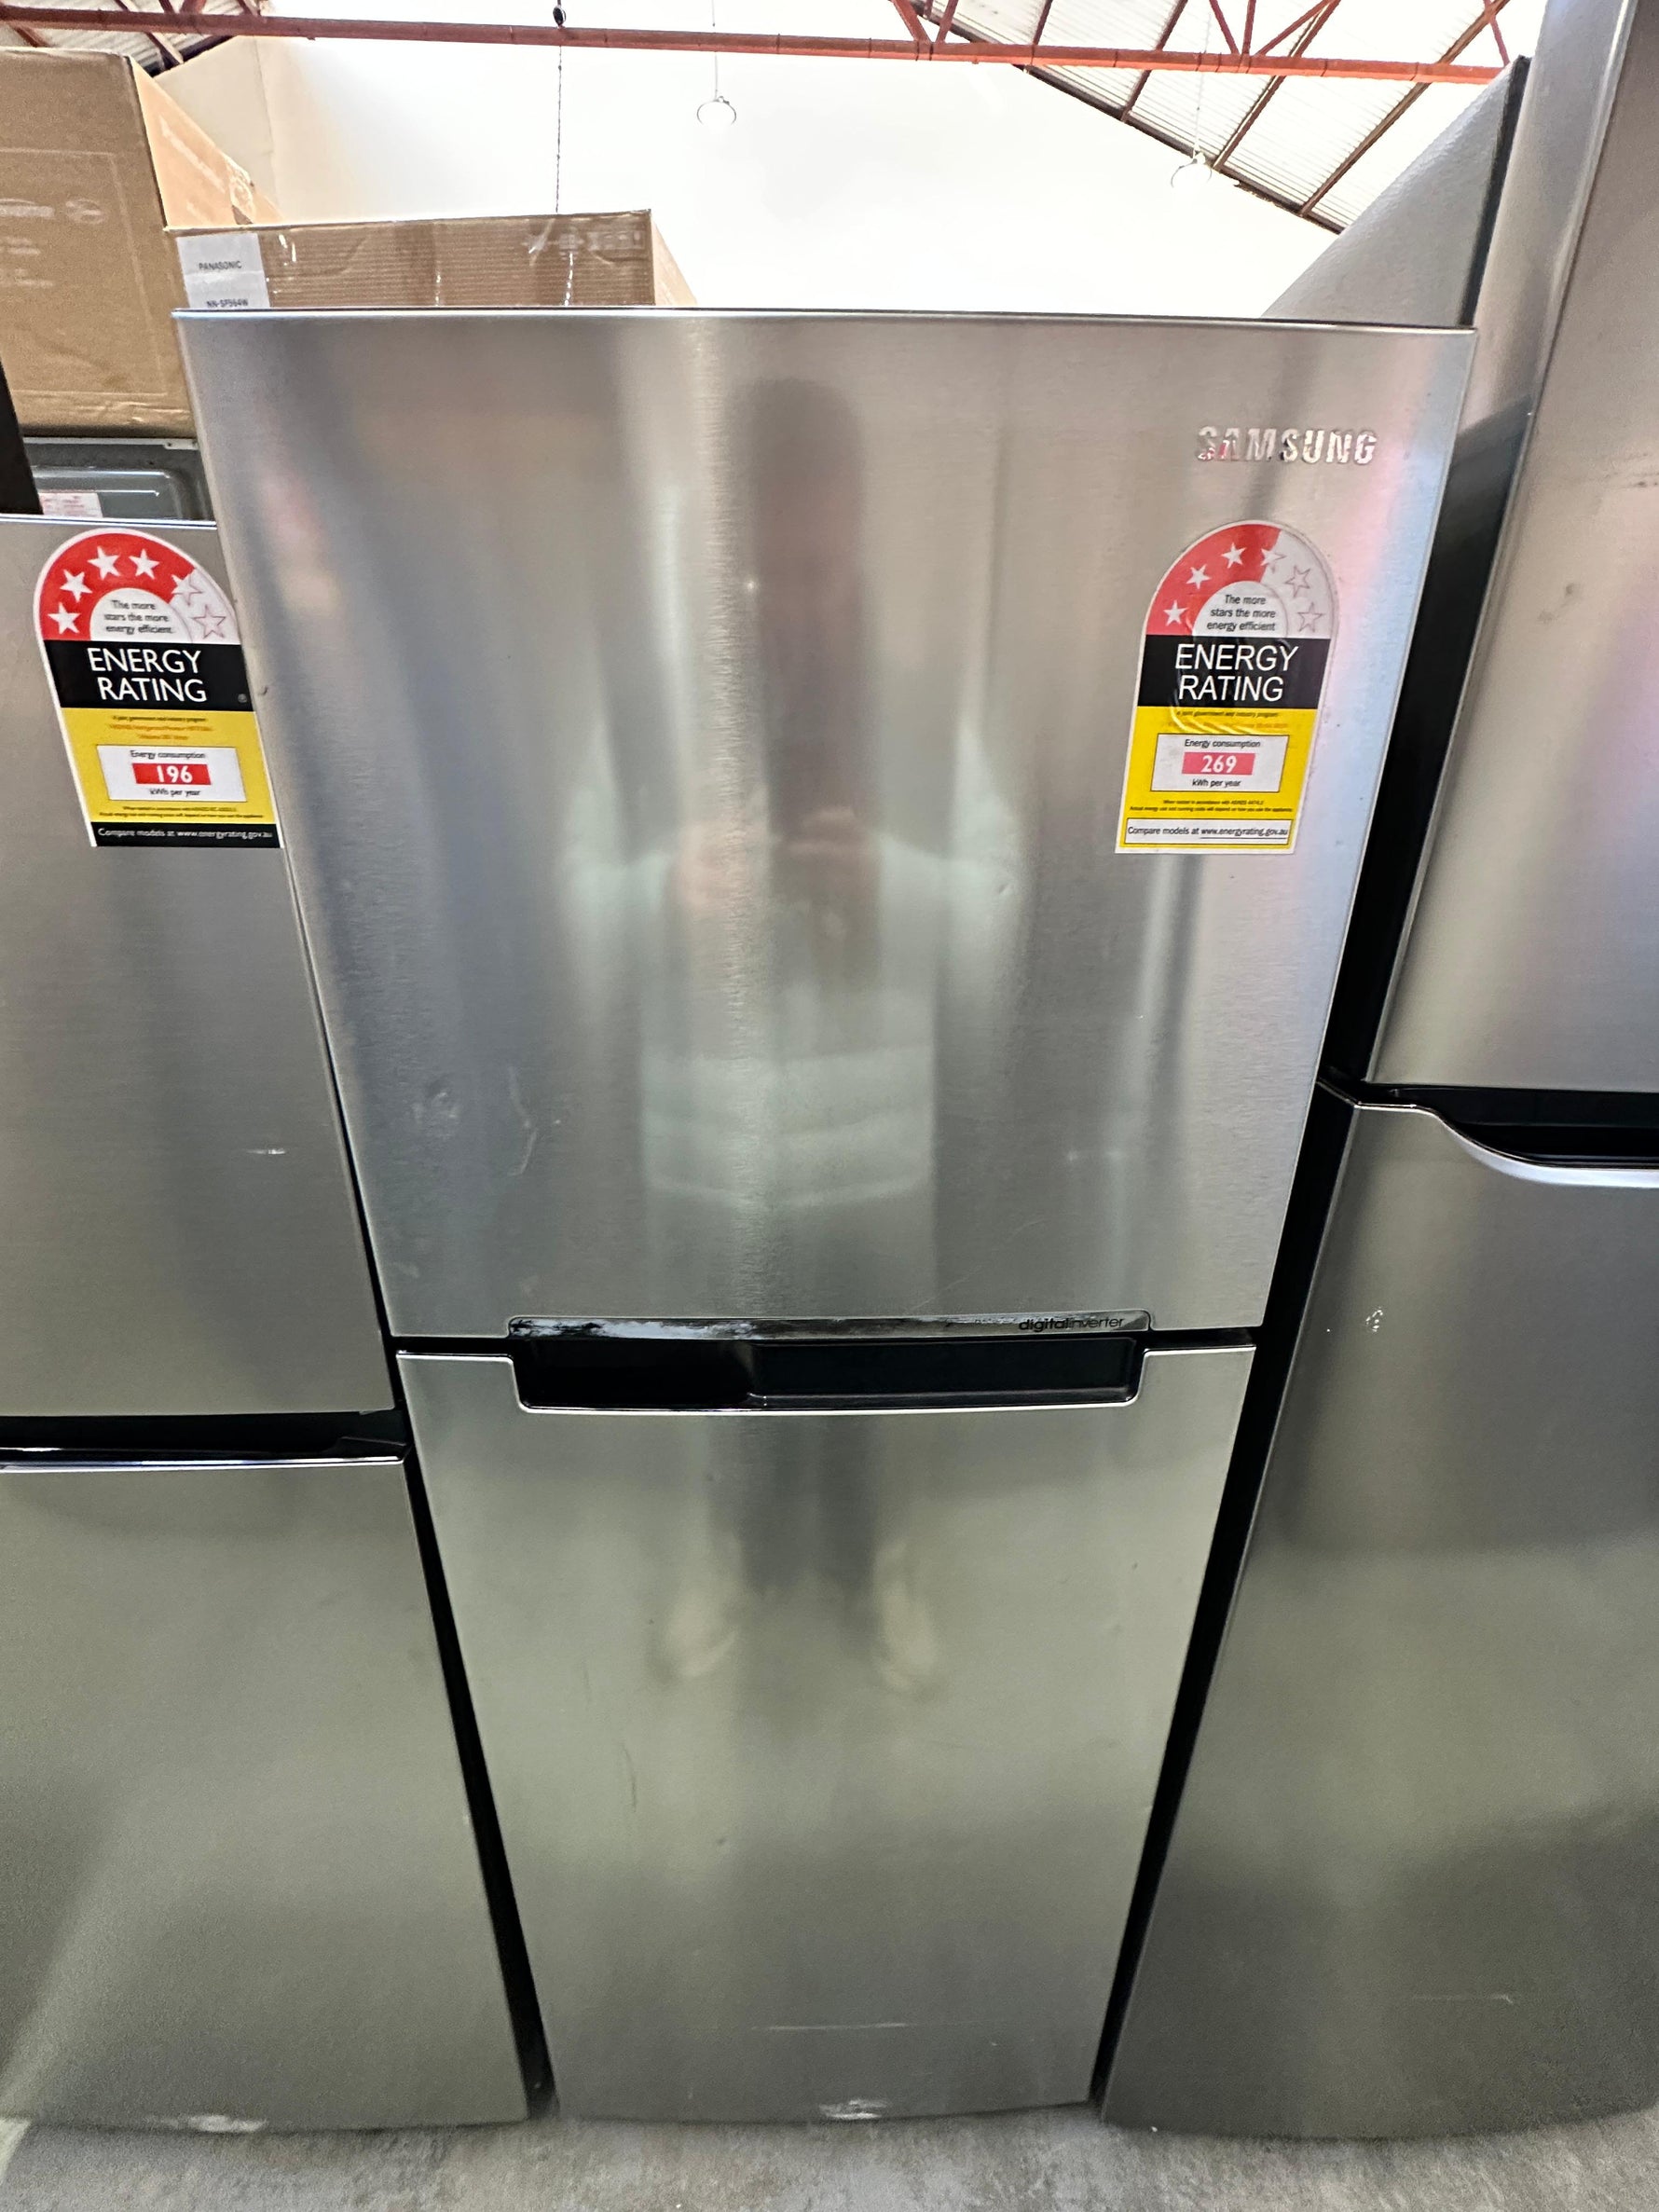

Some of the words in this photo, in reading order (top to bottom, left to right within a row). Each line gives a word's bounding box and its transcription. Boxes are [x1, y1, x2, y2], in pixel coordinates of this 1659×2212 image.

[199, 261, 242, 270] PANASONIC
[1197, 426, 1378, 465] SAMSUNG
[111, 599, 130, 610] The
[1226, 594, 1241, 604] The
[1242, 597, 1267, 605] more
[104, 613, 126, 622] stars
[127, 611, 143, 622] the
[1210, 609, 1233, 617] stars
[1235, 608, 1251, 617] the
[105, 625, 135, 636] energy
[137, 625, 174, 634] efficient
[1206, 622, 1237, 632] energy
[1239, 621, 1276, 631] efficient
[87, 647, 202, 674] ENERGY
[1175, 643, 1299, 672] ENERGY
[97, 677, 208, 703] RATING
[1178, 675, 1284, 702] RATING
[1185, 738, 1211, 749] Energy
[1212, 740, 1261, 749] consumption
[130, 749, 157, 760] Energy
[158, 751, 207, 760] consumption
[1200, 754, 1238, 774] 269
[156, 764, 194, 783] 196
[1192, 778, 1209, 787] kWh
[1224, 780, 1241, 789] year
[185, 790, 201, 798] year
[1128, 826, 1161, 836] Compare
[1162, 827, 1190, 835] models
